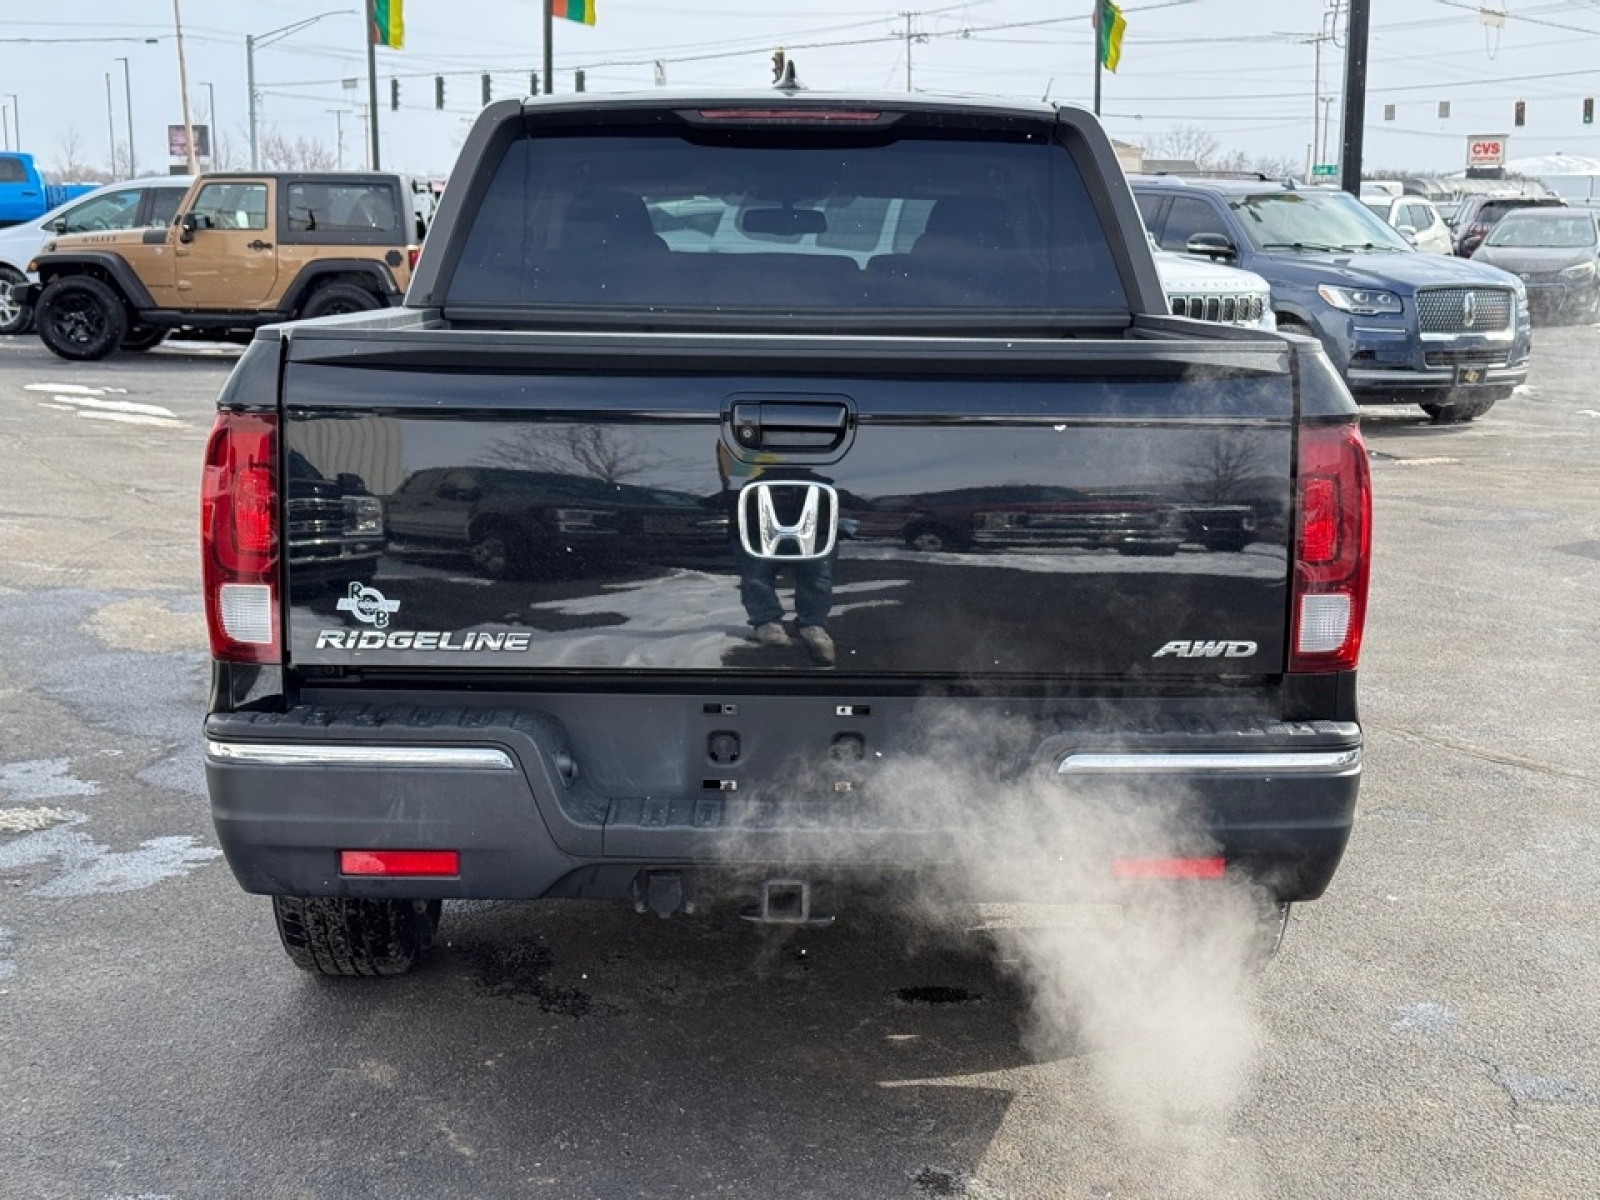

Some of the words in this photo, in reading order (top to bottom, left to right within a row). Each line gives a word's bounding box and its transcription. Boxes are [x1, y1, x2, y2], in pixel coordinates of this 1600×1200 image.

[1472, 142, 1501, 155] CVS
[315, 629, 532, 651] RIDGELINE
[1152, 640, 1258, 658] AWD
